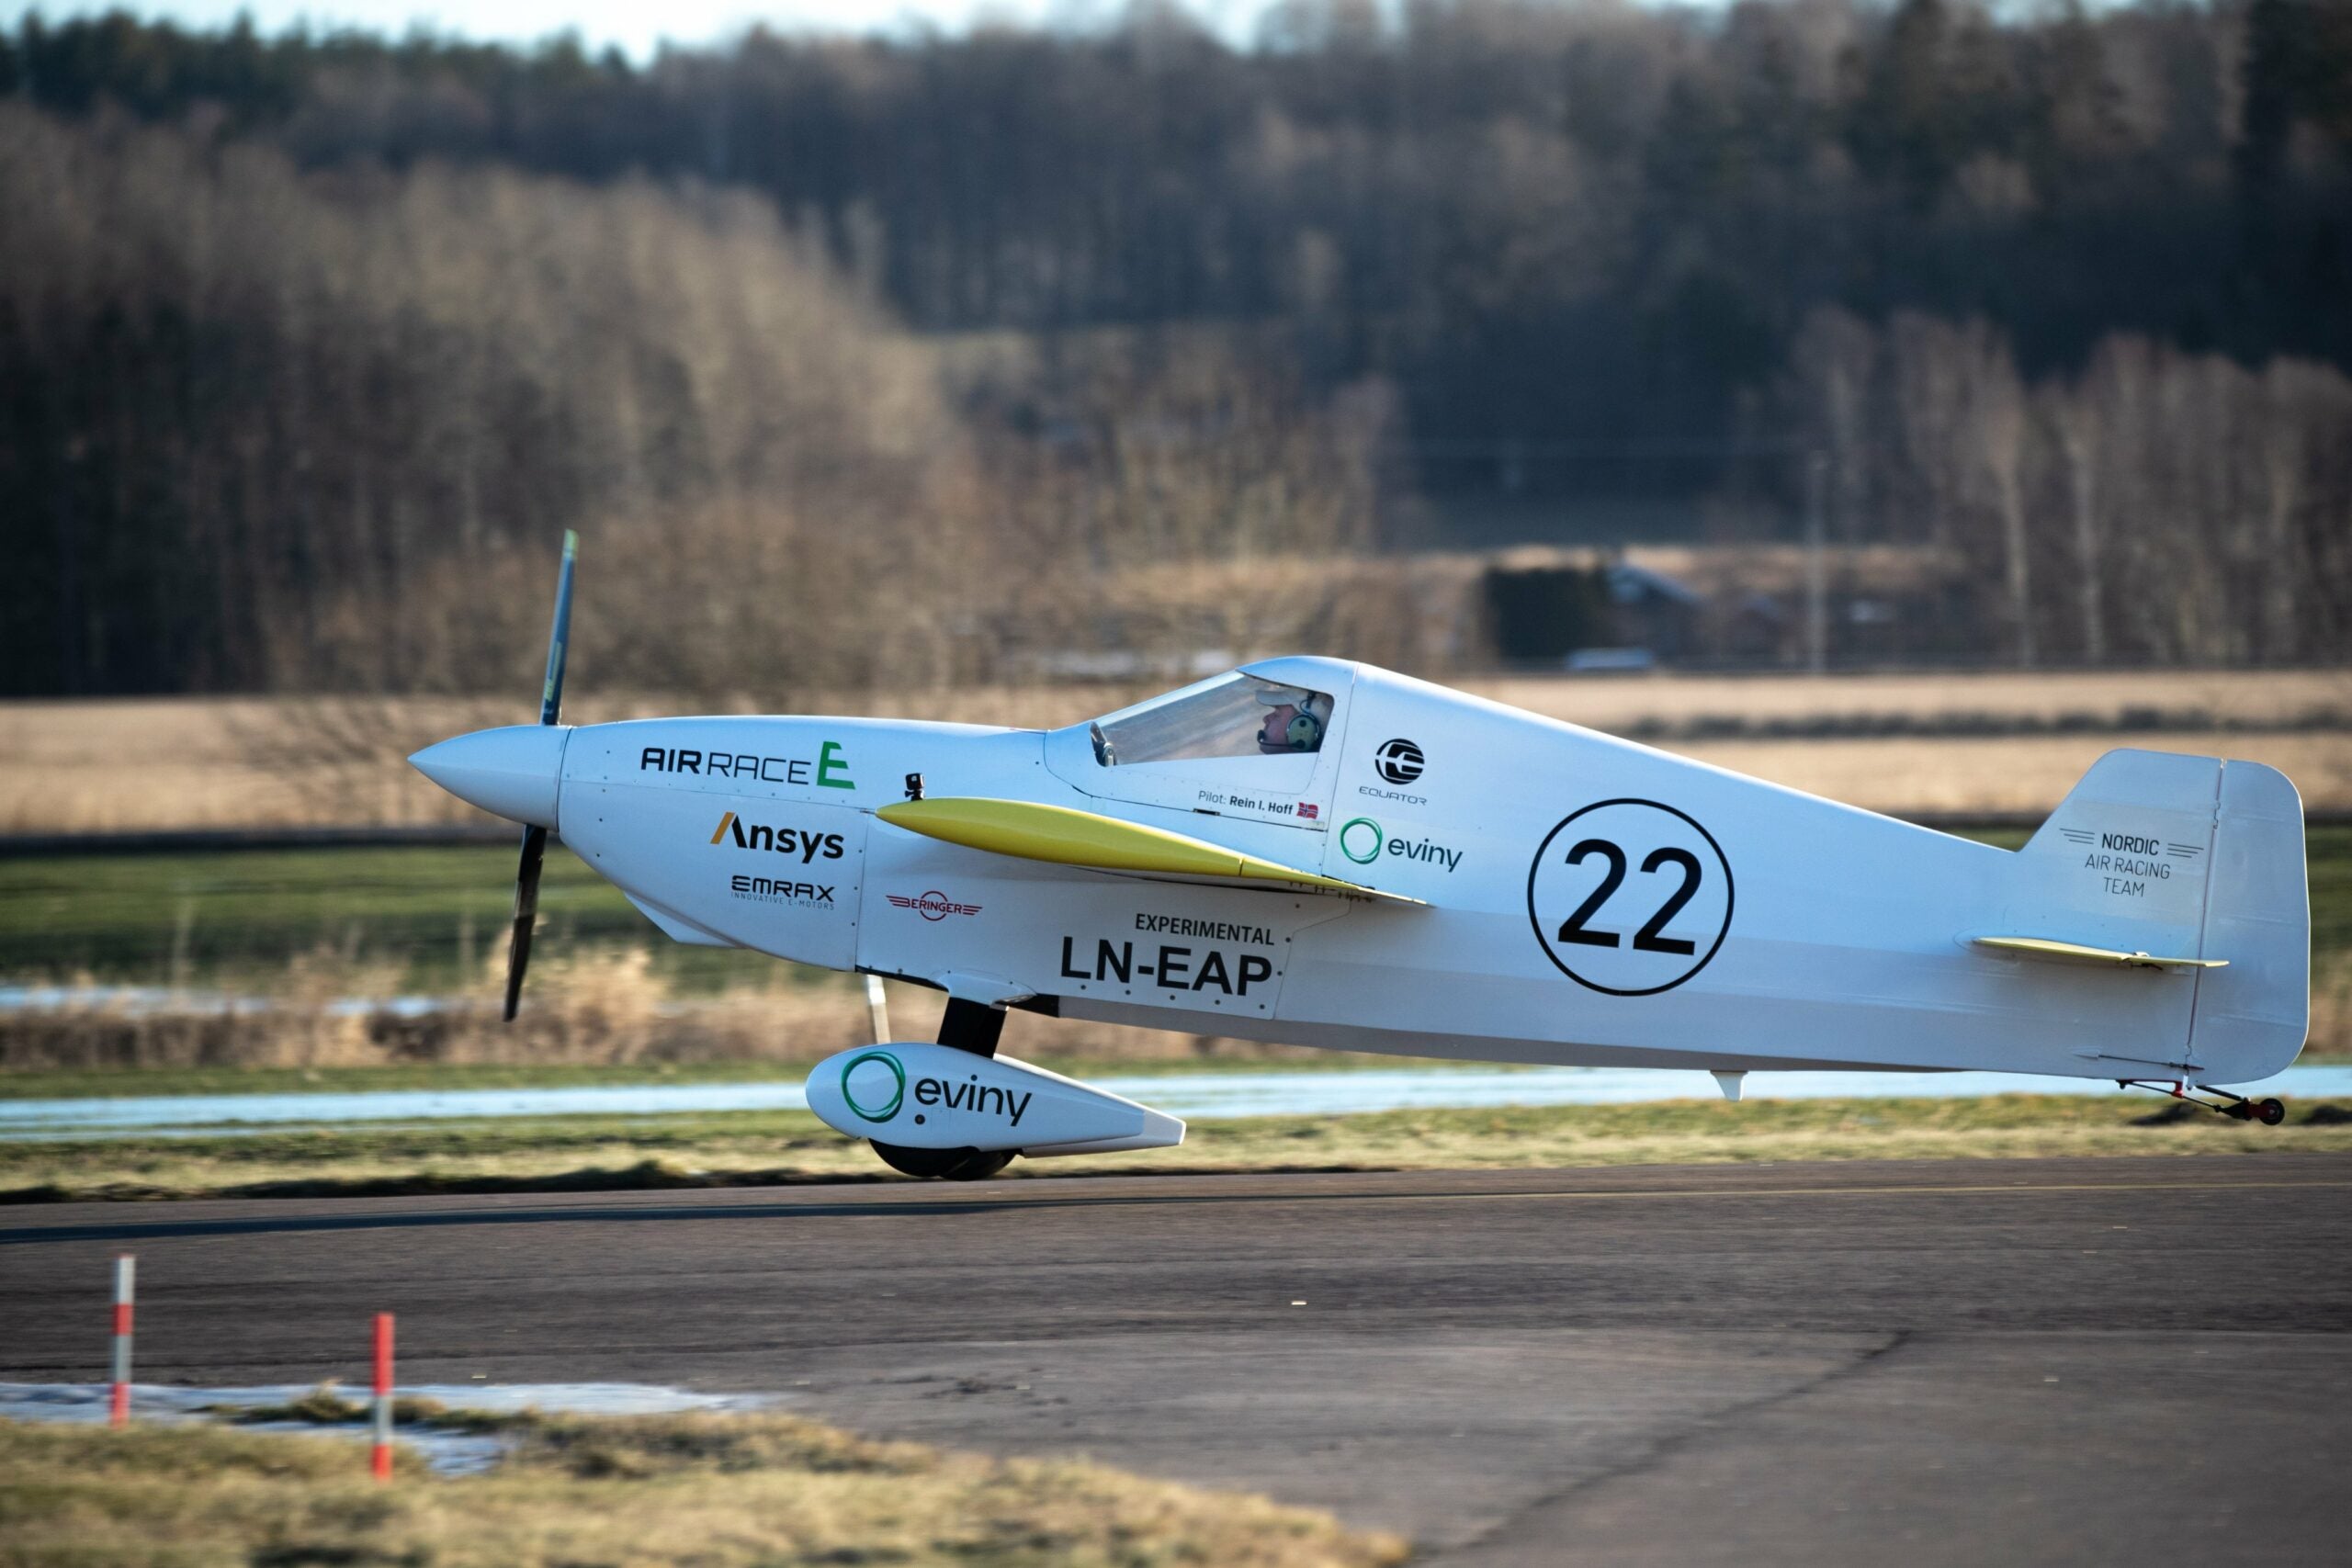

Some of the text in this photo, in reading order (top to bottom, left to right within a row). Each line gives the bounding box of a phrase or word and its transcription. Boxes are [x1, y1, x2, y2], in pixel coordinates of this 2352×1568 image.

[1198, 790, 1226, 805] Pilot:
[1229, 795, 1255, 808] Rein
[1268, 802, 1294, 815] Hoff
[1359, 785, 1428, 807] EQUATOR
[710, 811, 844, 864] Ansys
[2101, 833, 2160, 856] NORDIC
[1387, 838, 1464, 873] eviny
[2085, 853, 2171, 880] AIR RACING
[731, 874, 835, 903] EMRAX
[1557, 839, 1703, 956] 22
[2103, 876, 2145, 897] TEAM
[730, 891, 835, 911] INNOVATIVE E-MOTORS
[886, 895, 963, 915] BERINGER
[1135, 913, 1275, 946] EXPERIMENTAL
[1060, 935, 1273, 997] LN-EAP
[914, 1074, 1033, 1127] eviny
